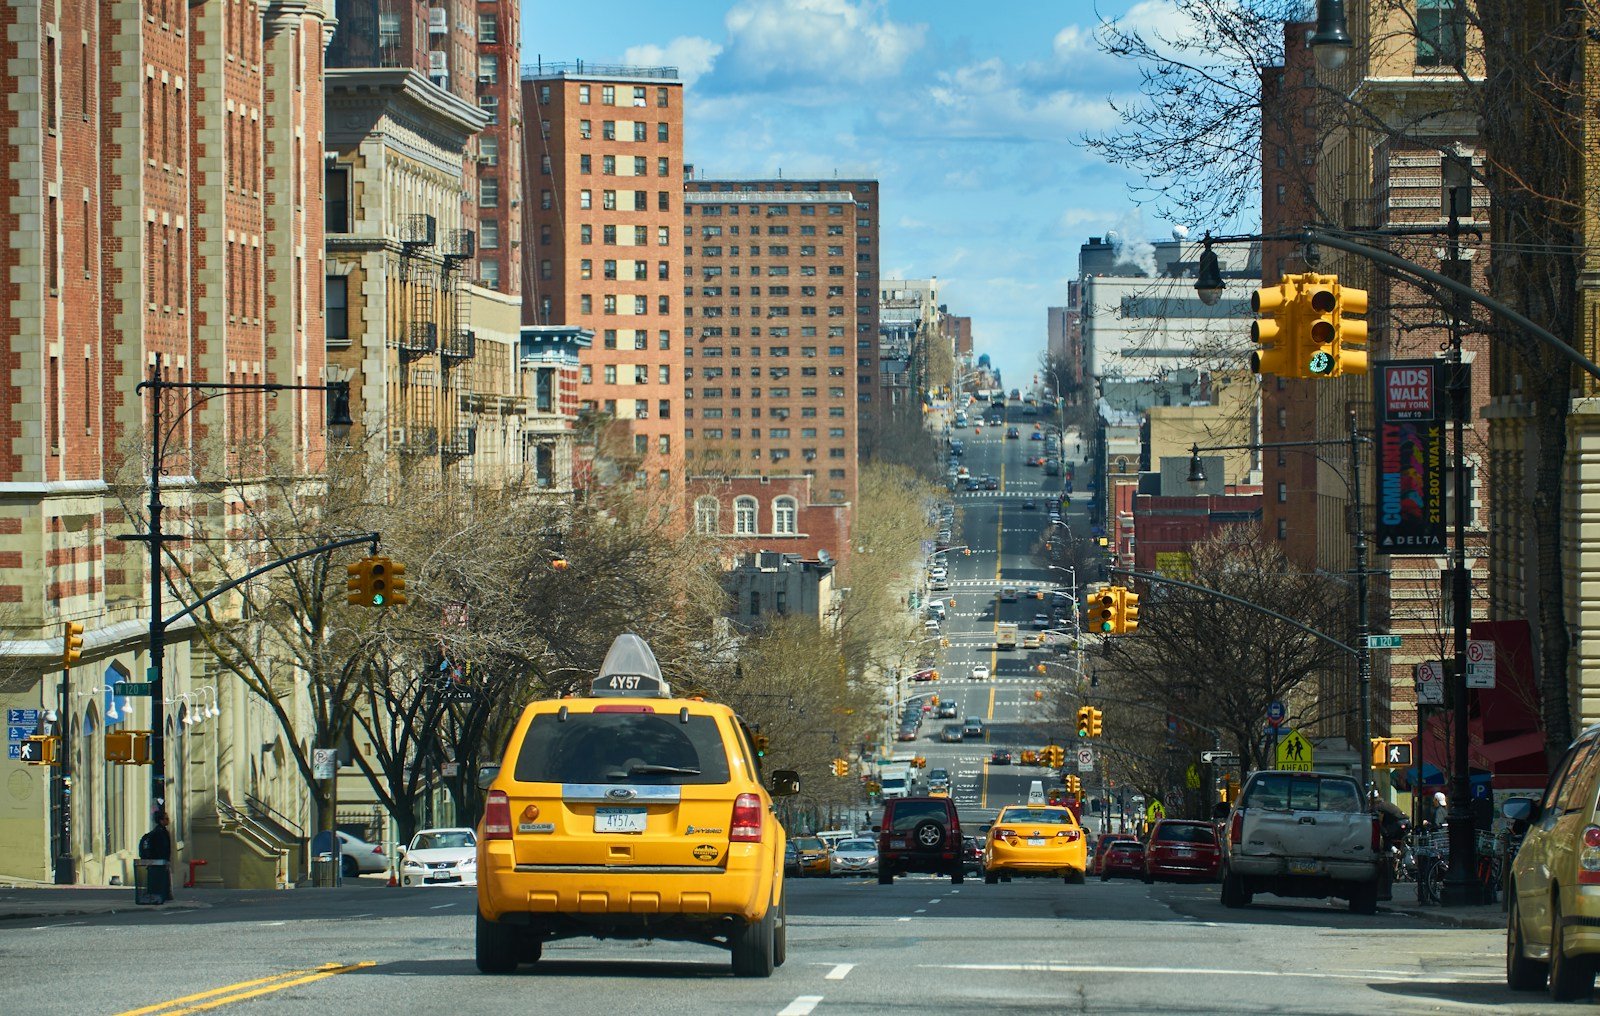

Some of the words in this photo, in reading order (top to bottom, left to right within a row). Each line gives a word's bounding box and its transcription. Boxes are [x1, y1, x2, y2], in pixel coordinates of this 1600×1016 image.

[1390, 370, 1428, 386] AIDS
[1390, 388, 1428, 400] WALK
[1409, 401, 1429, 409] YORK
[1382, 423, 1402, 525] COMMUNITY
[1428, 426, 1440, 524] 212.807.WALK
[1397, 535, 1440, 545] DELTA
[1371, 638, 1377, 646] W
[1380, 637, 1391, 646] 120
[609, 676, 641, 689] 4Y57
[115, 685, 122, 694] W
[125, 685, 139, 694] 120
[1281, 764, 1309, 772] AHEAD
